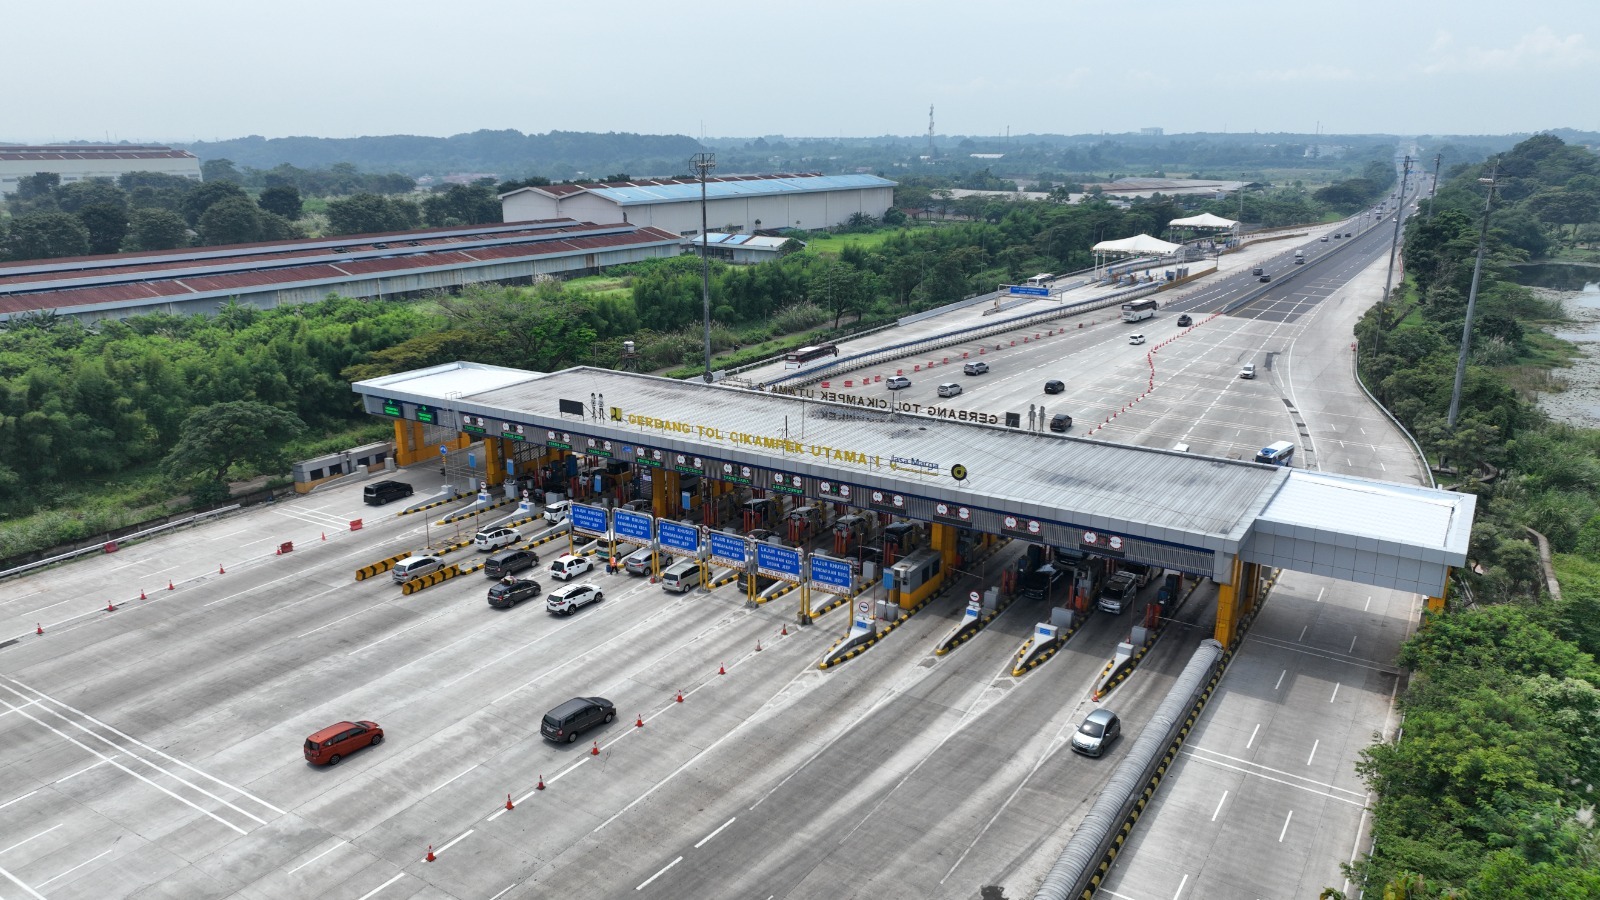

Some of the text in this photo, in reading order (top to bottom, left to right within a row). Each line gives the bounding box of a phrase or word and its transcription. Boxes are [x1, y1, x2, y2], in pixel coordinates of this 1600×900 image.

[628, 414, 690, 434] GERBANG
[697, 425, 723, 440] TOL
[730, 431, 803, 454] CIKAMPEK
[812, 445, 867, 465] UTAMA
[890, 455, 939, 470] Jasa Marga
